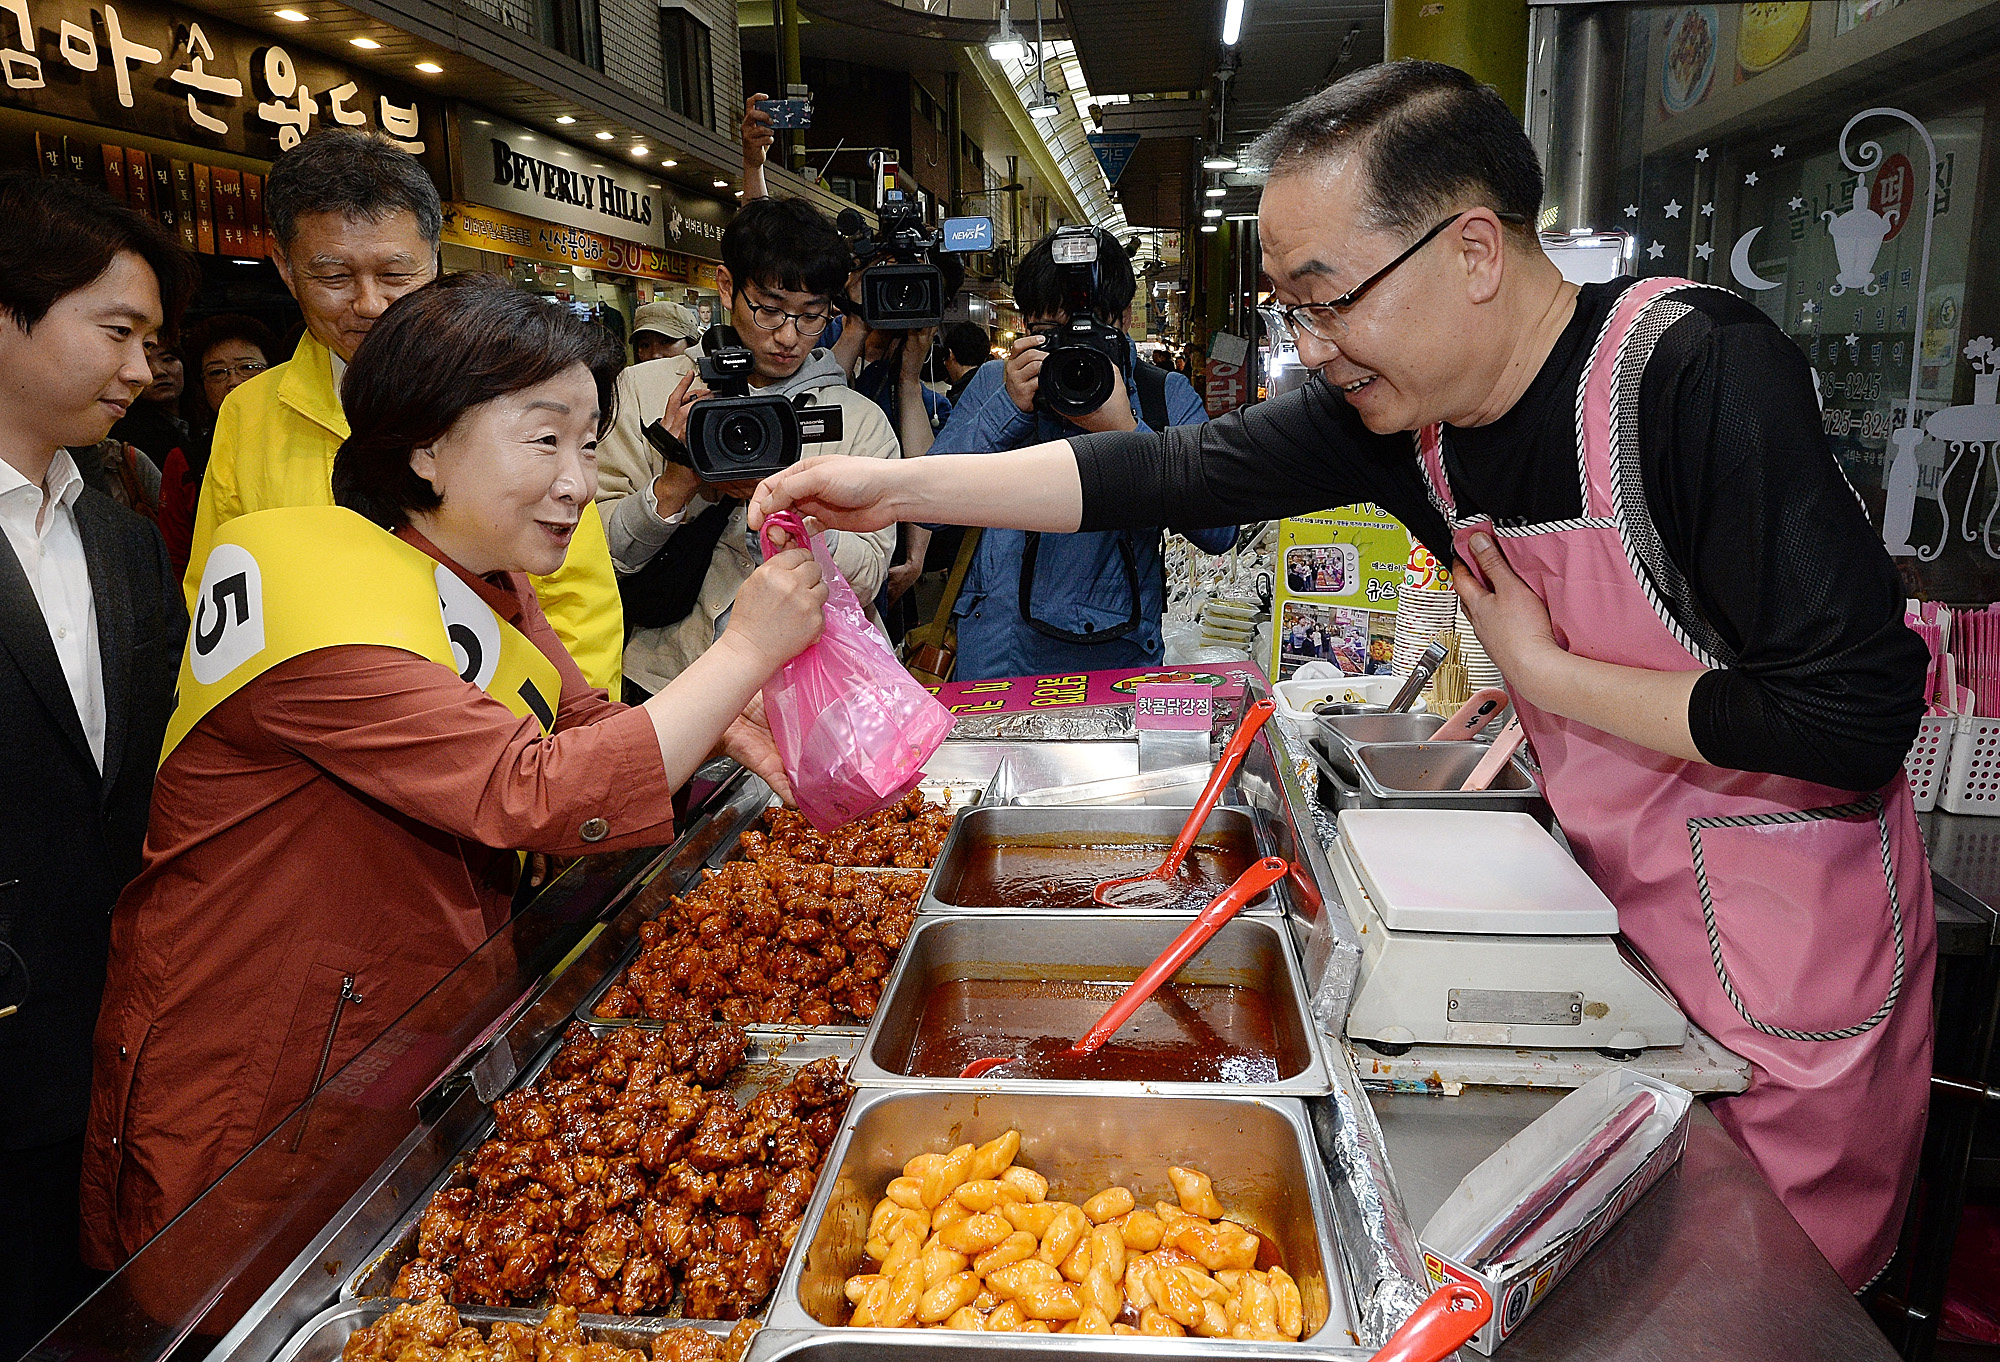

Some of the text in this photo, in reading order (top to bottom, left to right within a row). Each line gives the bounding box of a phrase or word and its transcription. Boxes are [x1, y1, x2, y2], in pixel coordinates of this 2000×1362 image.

[1101, 148, 1125, 163] 카드
[491, 138, 652, 226] BEVERLY HILLS
[538, 228, 604, 260] 신상품입하
[649, 250, 687, 276] SALE
[1366, 578, 1401, 602] 큐스
[196, 571, 250, 657] 5
[1138, 697, 1210, 716] 핫콤닭강정
